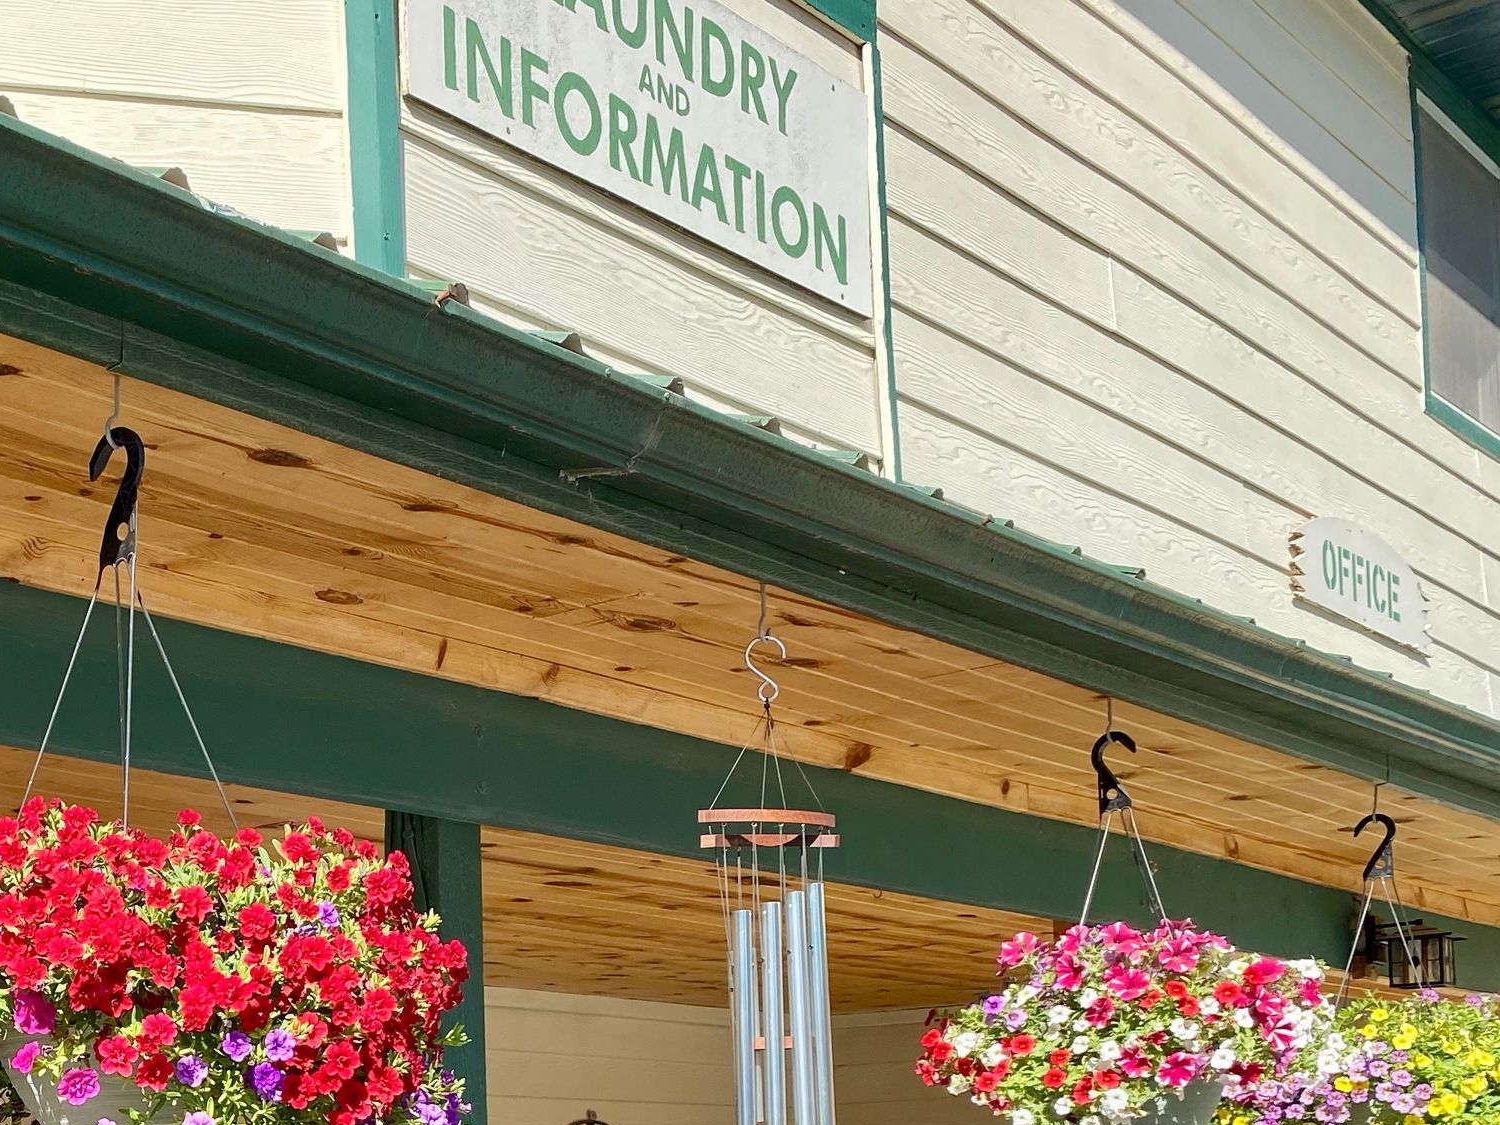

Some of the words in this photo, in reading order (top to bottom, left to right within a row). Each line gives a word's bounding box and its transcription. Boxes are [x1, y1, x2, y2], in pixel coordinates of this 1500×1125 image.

[552, 0, 798, 137] UNDRY
[638, 63, 690, 117] AND
[443, 5, 848, 285] INFORMATION
[1323, 539, 1401, 623] OFFICE
